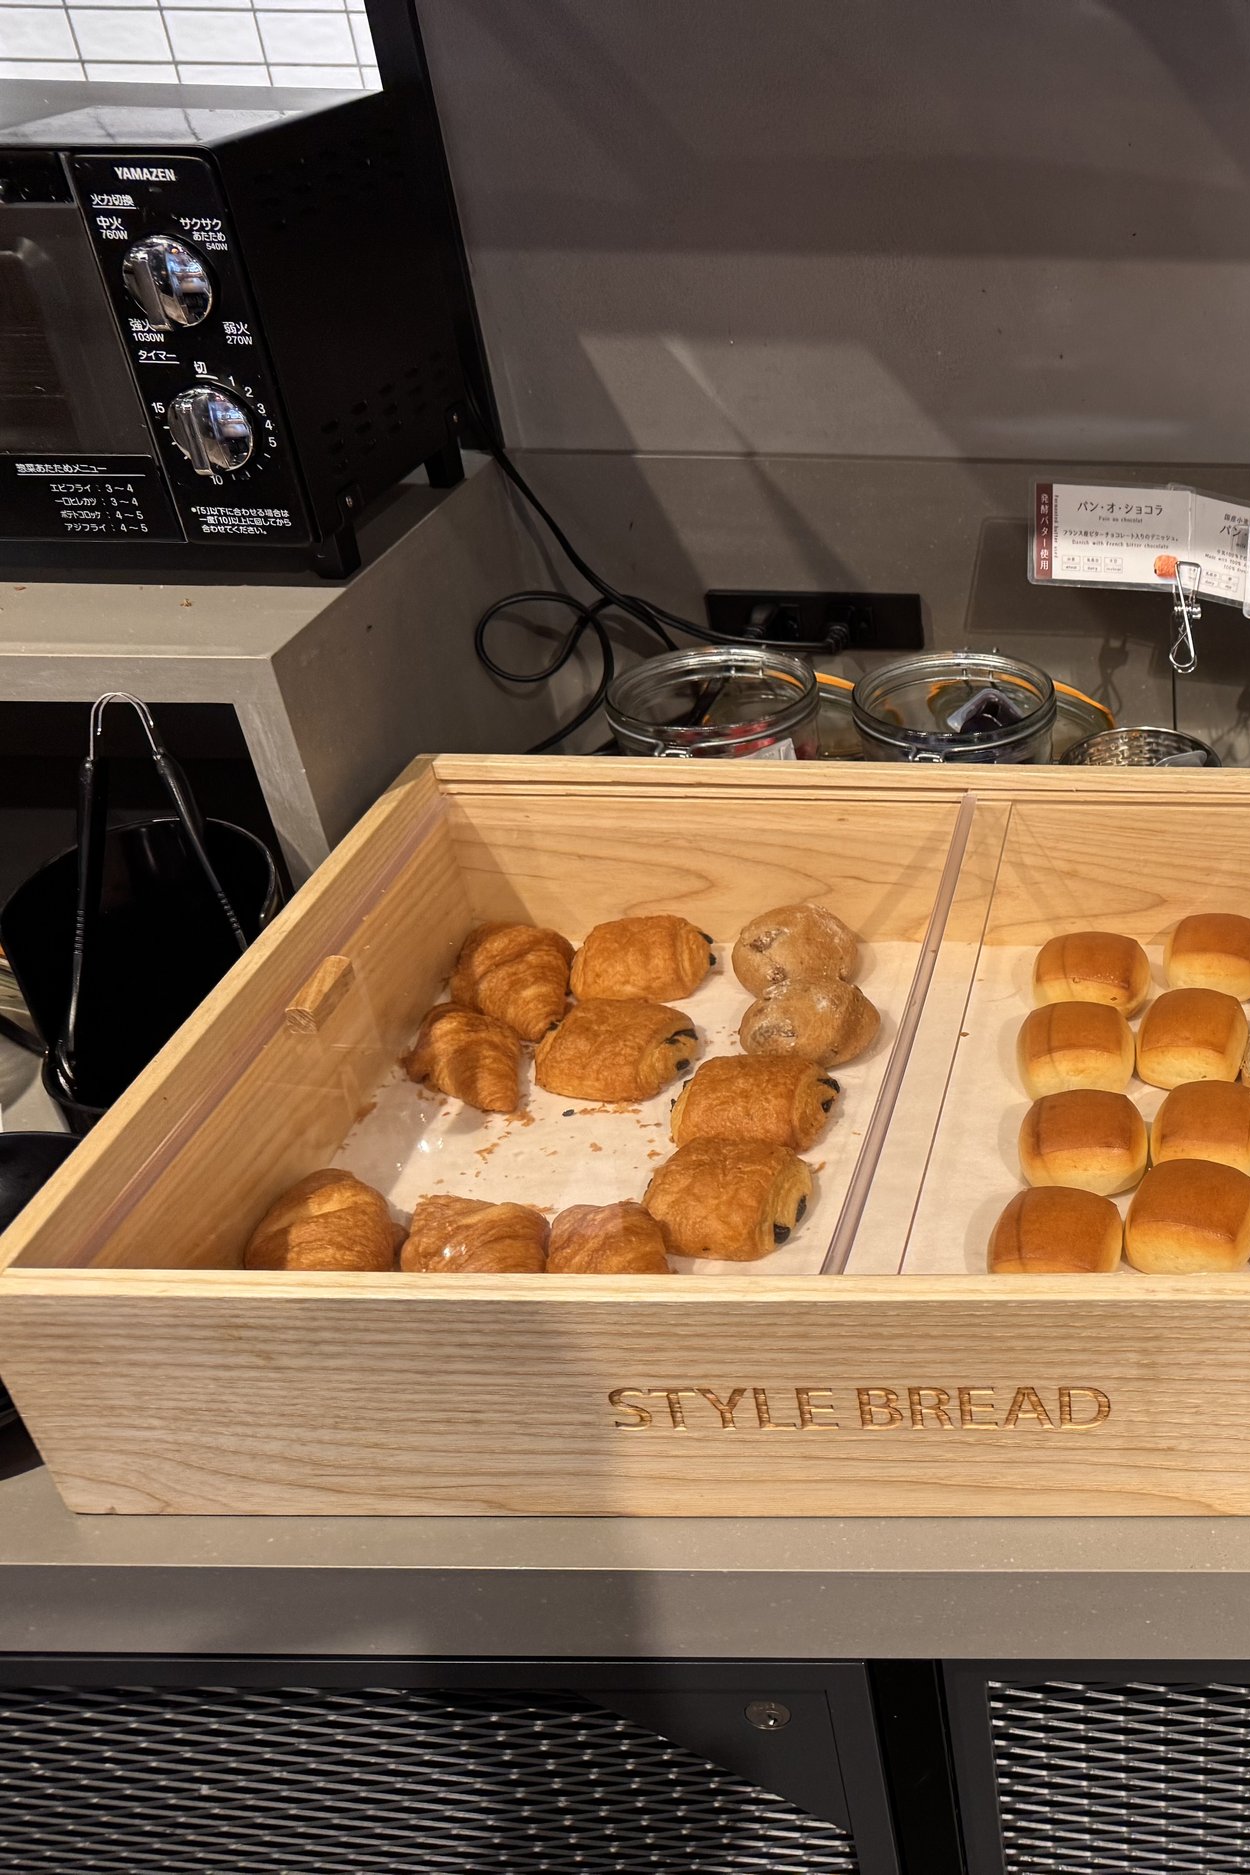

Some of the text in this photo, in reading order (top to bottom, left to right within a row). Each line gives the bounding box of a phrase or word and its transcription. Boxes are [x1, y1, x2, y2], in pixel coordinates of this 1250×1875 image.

[114, 167, 176, 182] YAMAZEN
[90, 193, 135, 206] 火力切換
[96, 216, 124, 230] 中火
[179, 217, 222, 231] サクサク
[100, 229, 128, 240] 760W
[192, 231, 226, 242] あたため
[206, 243, 228, 251] 540W
[222, 322, 250, 335] 弱火
[133, 333, 165, 342] 1030W
[226, 335, 253, 345] 270W
[138, 350, 177, 361] タイマー
[194, 361, 208, 374] 切
[228, 375, 236, 386] 1
[244, 386, 254, 398] 2
[152, 402, 165, 414] 15
[257, 403, 266, 414] 3
[265, 420, 273, 430] 4
[268, 436, 277, 448] 5
[210, 475, 224, 485] 10
[1077, 501, 1163, 516] パン・オ・ショコラ
[1040, 493, 1049, 570] 発酵バター使用
[608, 1386, 1111, 1431] STYLE BREAD
